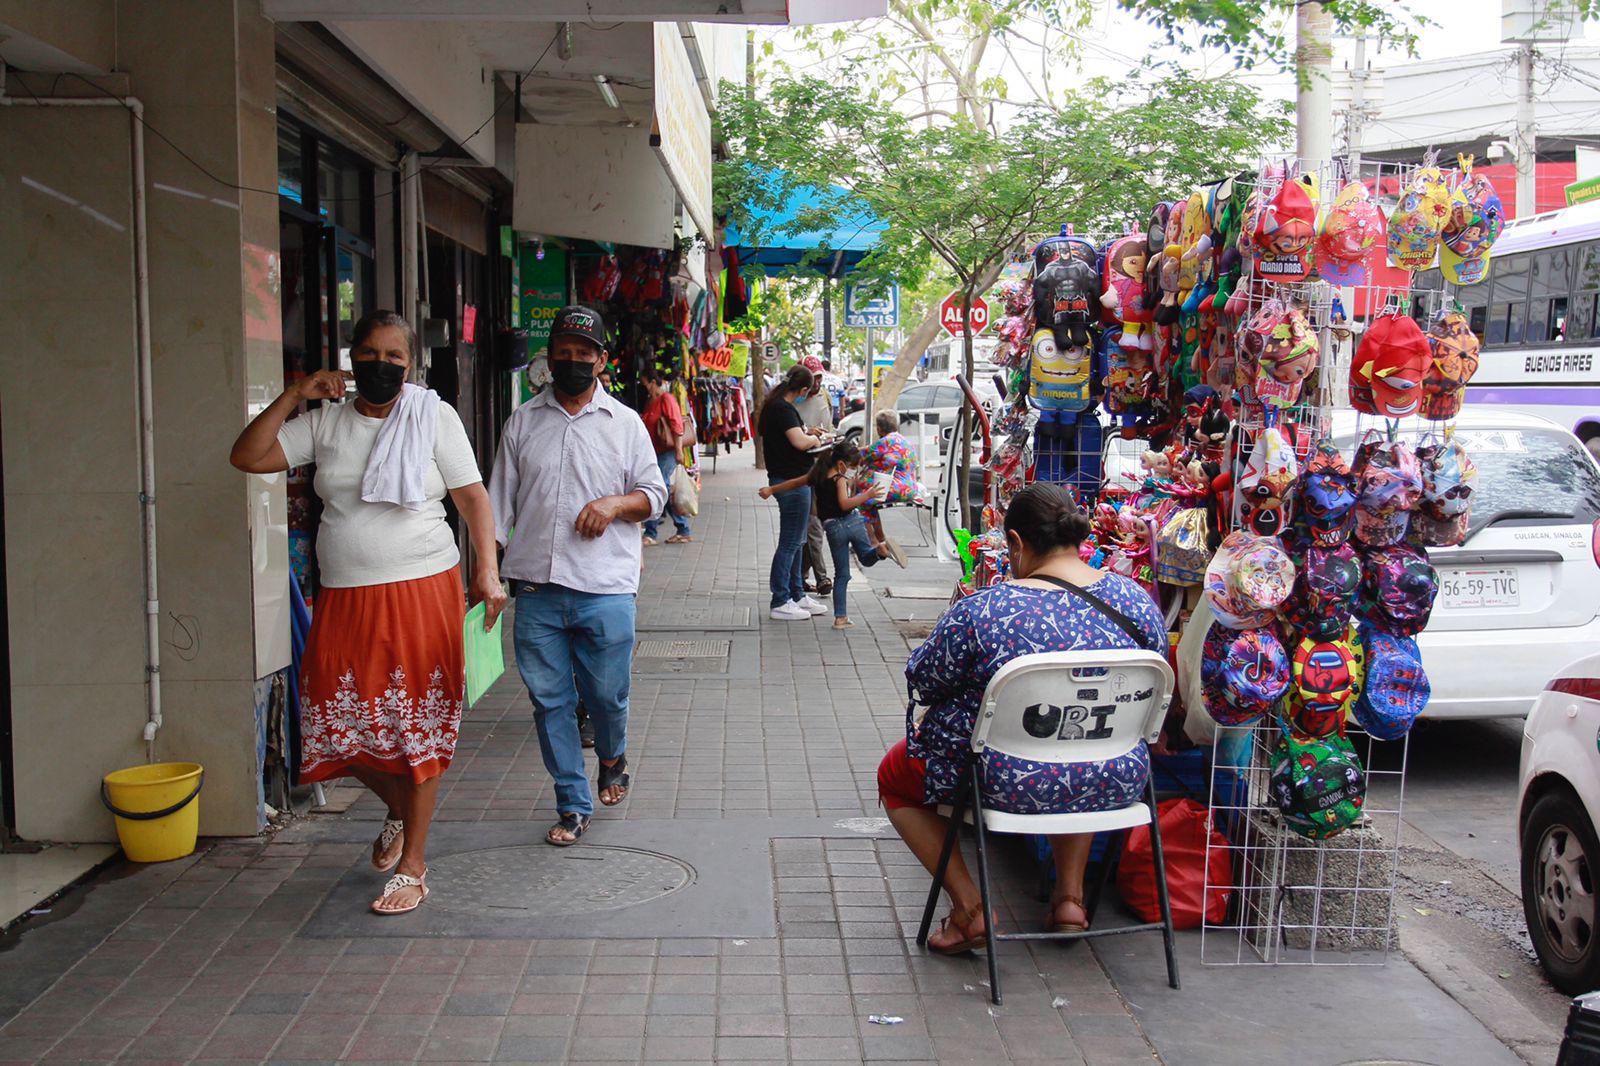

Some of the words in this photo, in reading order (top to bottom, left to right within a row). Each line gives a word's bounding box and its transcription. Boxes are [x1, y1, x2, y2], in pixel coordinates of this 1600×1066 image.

[1276, 254, 1299, 262] SUPER
[1260, 261, 1283, 273] MARIO
[1283, 263, 1304, 274] BROS.
[847, 314, 894, 325] TAXIS
[765, 346, 774, 357] E
[1525, 355, 1562, 373] BUENOS
[1563, 354, 1593, 372] AIRES
[1514, 532, 1552, 540] CULIACAN,
[1553, 531, 1583, 540] SINALOA
[1443, 578, 1517, 597] 56-59-TVC
[1022, 703, 1117, 740] URI
[1318, 789, 1344, 808] AMONG
[1346, 785, 1358, 795] US
